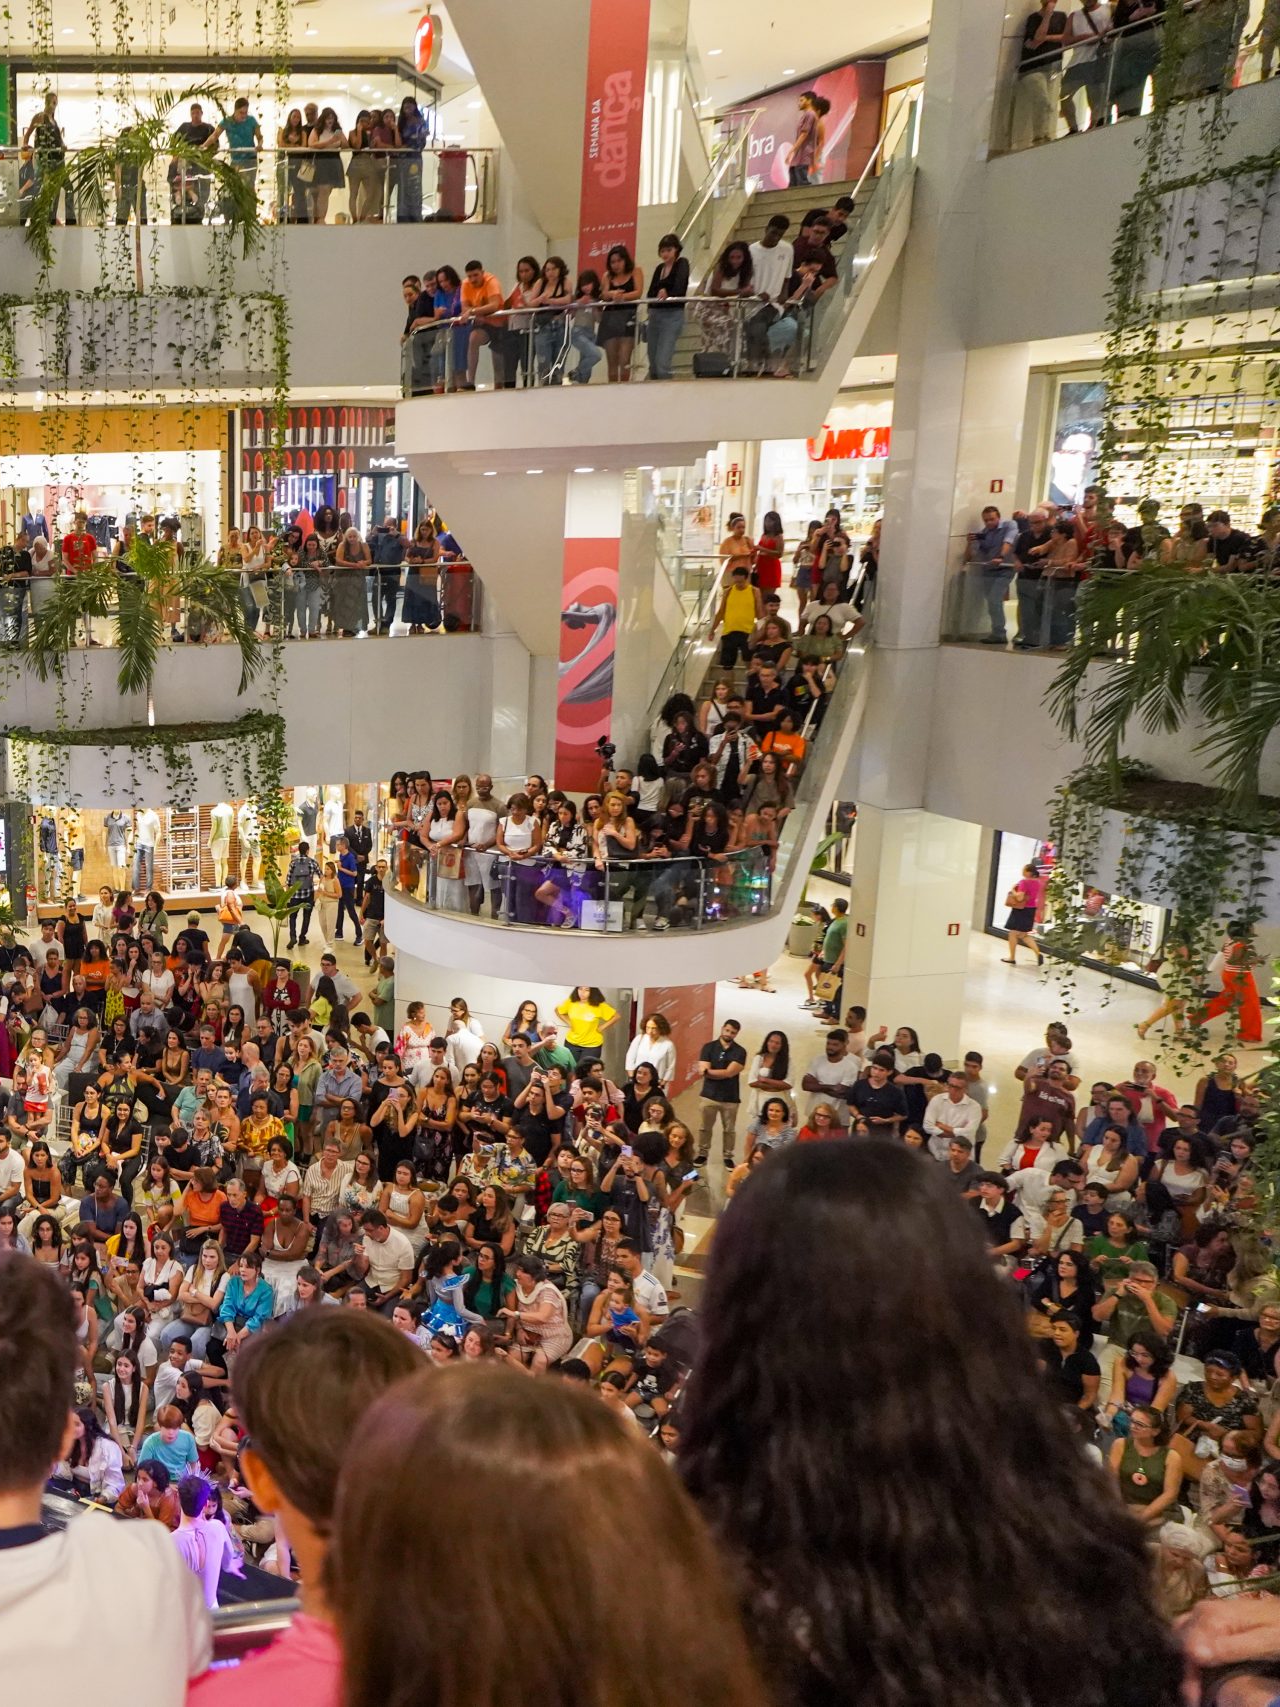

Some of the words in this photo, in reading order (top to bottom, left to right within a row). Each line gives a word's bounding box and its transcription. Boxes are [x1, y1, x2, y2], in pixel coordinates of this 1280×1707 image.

[591, 98, 602, 114] DA
[589, 116, 601, 159] SEMANA
[593, 70, 642, 188] dança
[748, 134, 775, 159] bra
